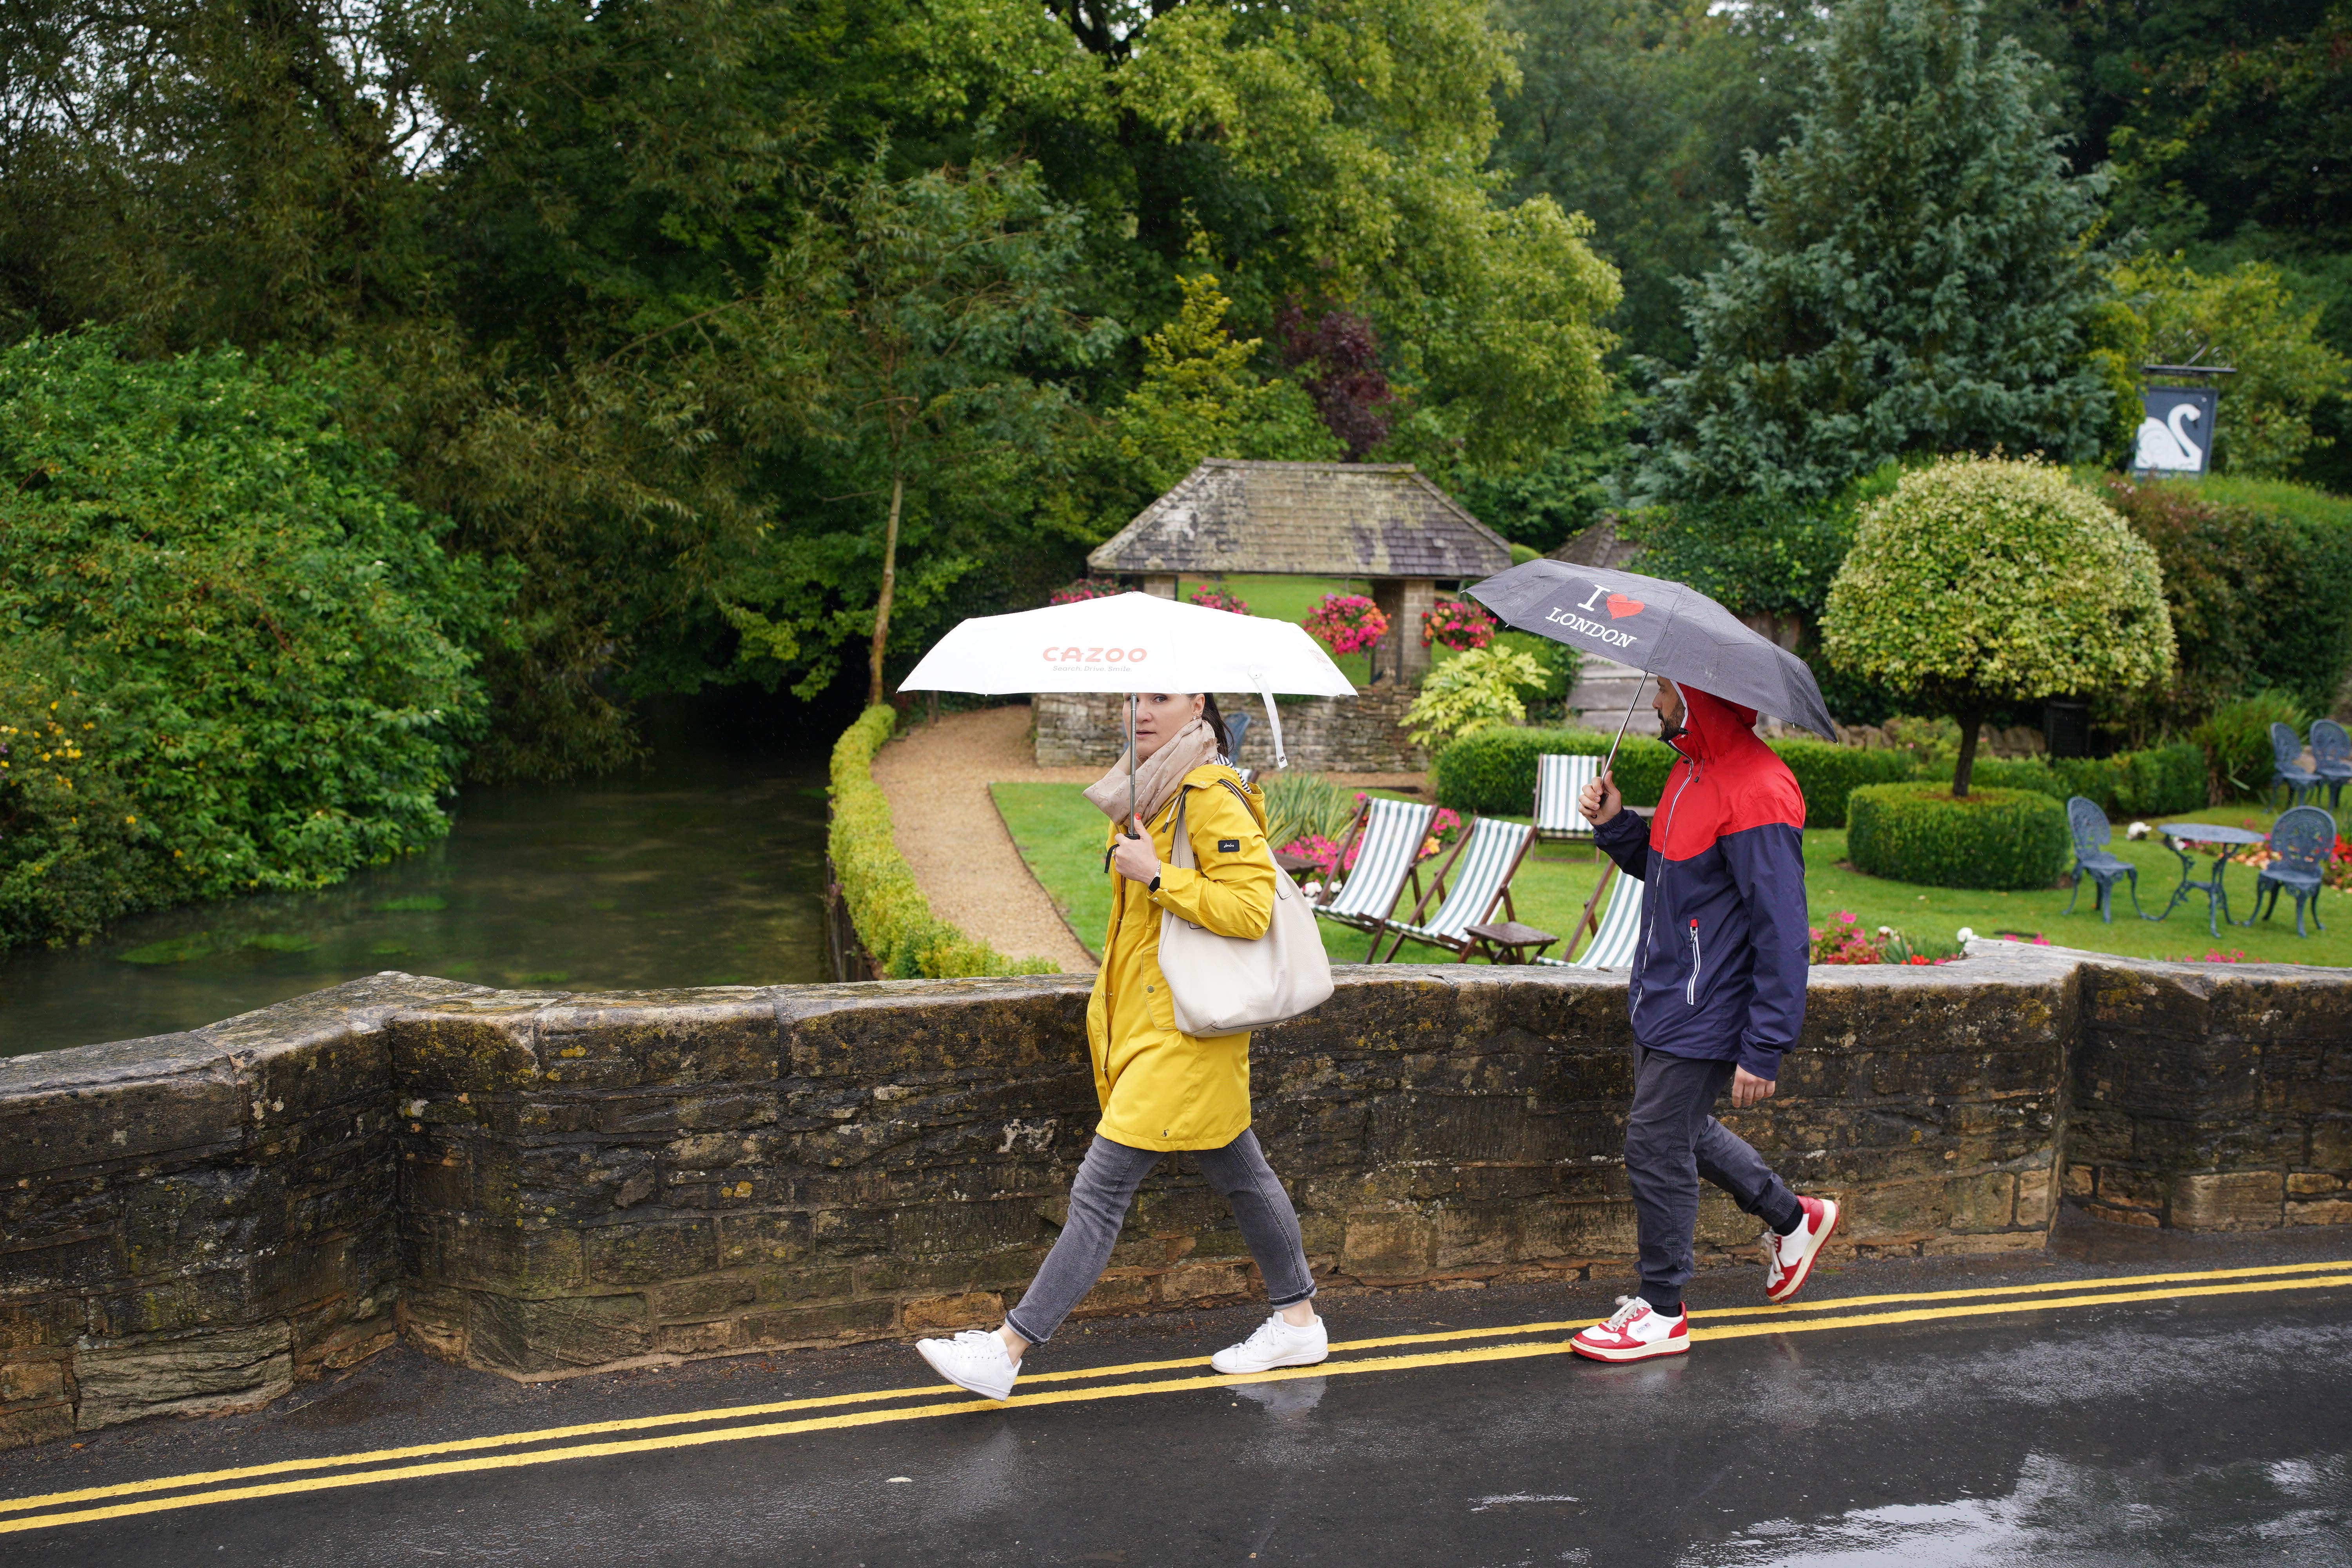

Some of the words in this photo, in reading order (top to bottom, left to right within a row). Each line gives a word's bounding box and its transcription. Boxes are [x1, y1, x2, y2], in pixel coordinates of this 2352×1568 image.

[1577, 584, 1611, 612] I
[1545, 607, 1637, 648] LONDON
[1043, 647, 1147, 662] CAZOO
